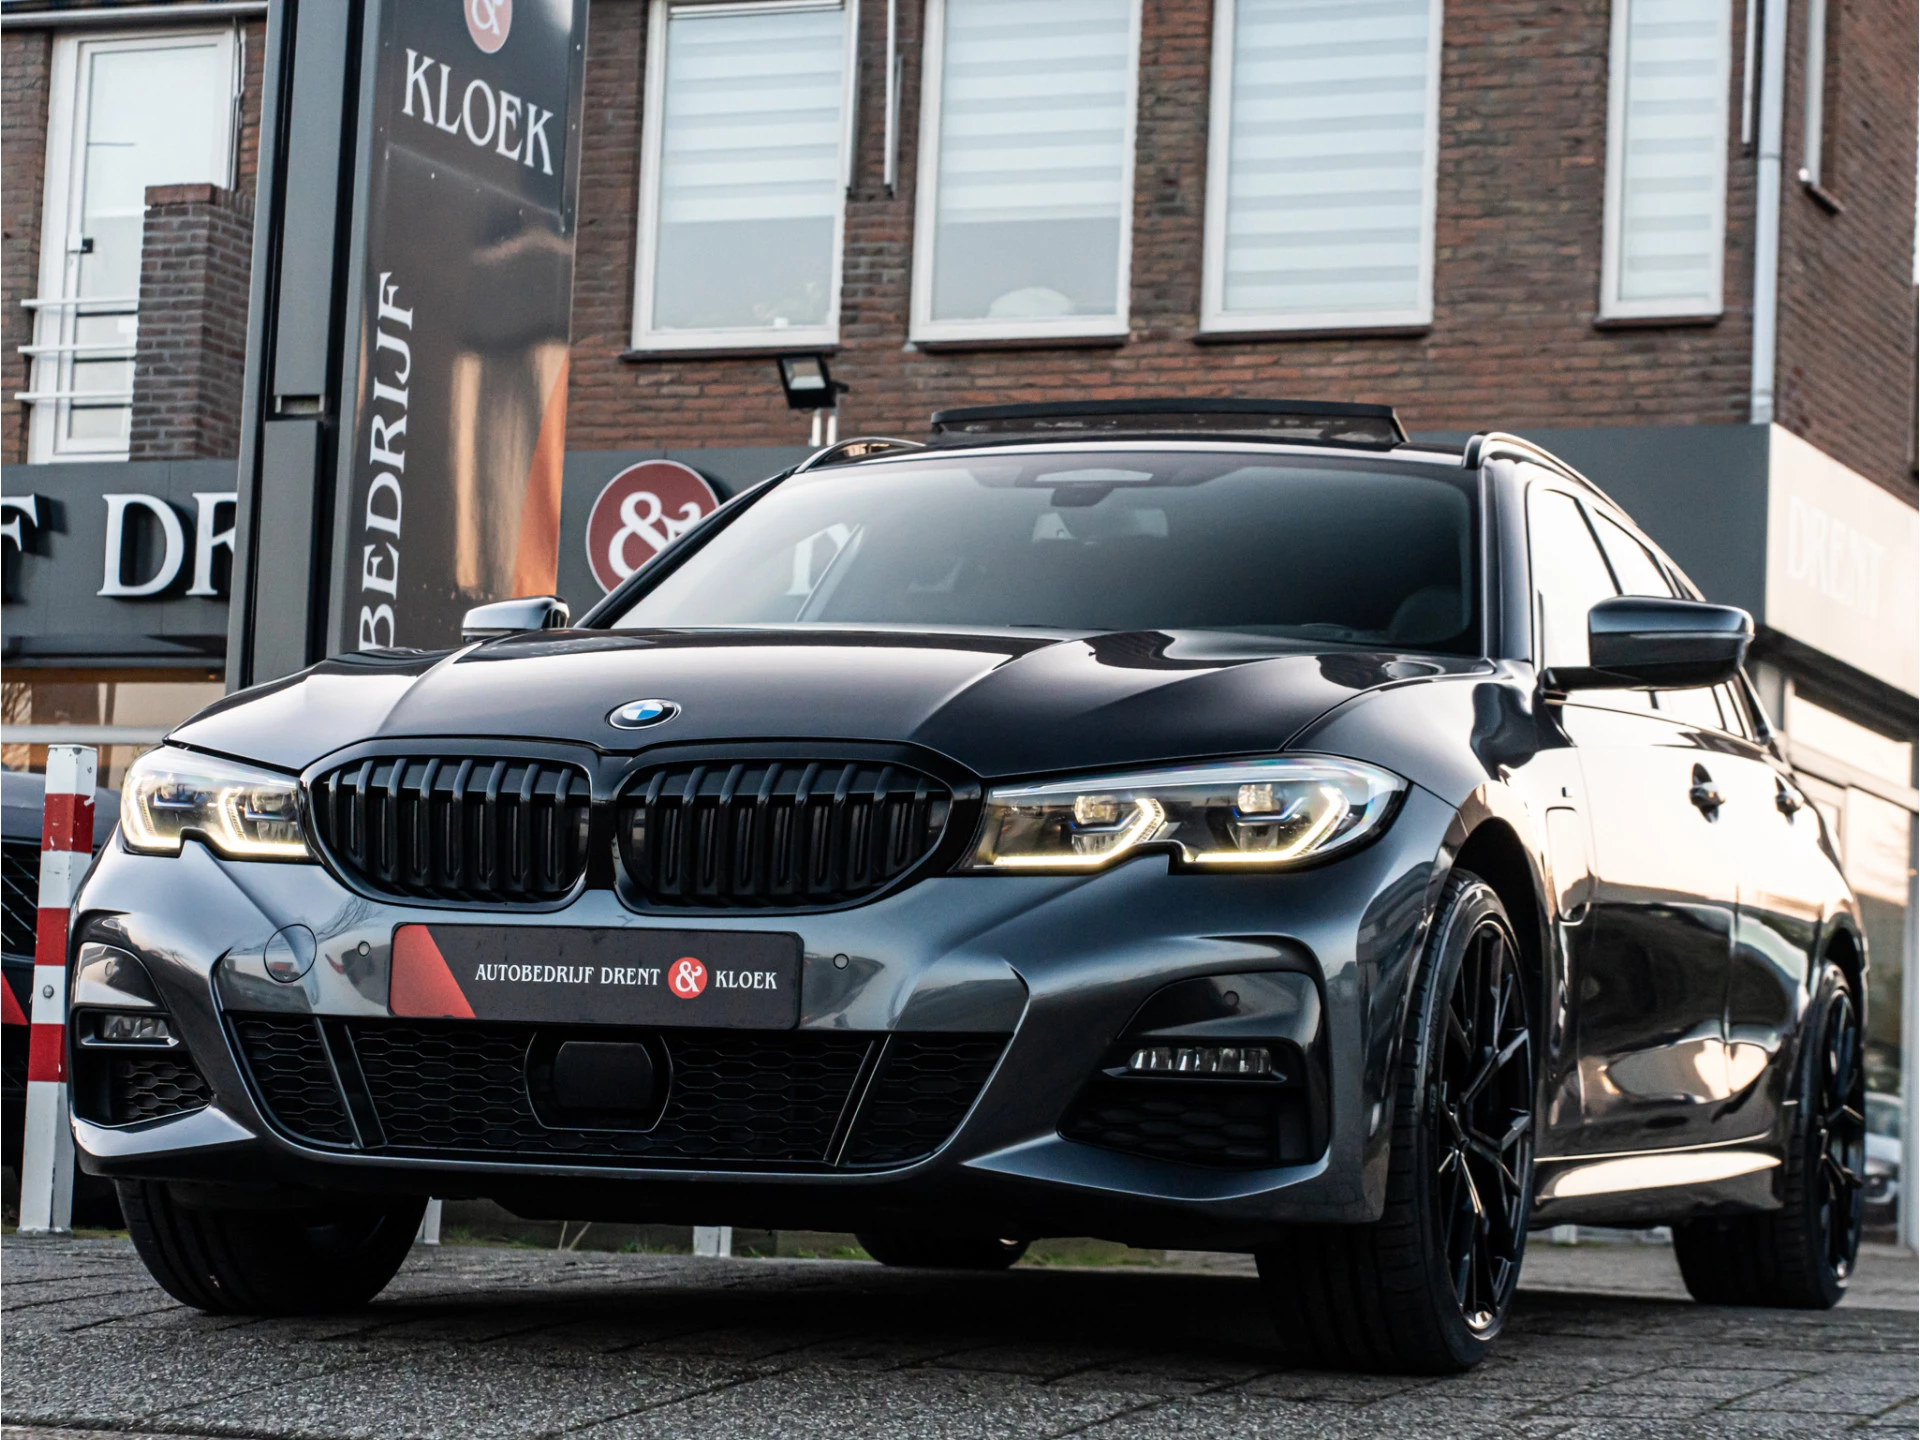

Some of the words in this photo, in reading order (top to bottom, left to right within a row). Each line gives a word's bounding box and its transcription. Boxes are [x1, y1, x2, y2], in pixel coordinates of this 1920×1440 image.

[402, 48, 554, 176] KLOEK
[358, 272, 413, 651] BEDRIJF
[1786, 494, 1885, 619] DRENT
[475, 963, 595, 984] AUTOBEDRIJF
[600, 967, 661, 986] DRENT
[675, 961, 703, 992] &
[715, 970, 778, 990] KLOEK
